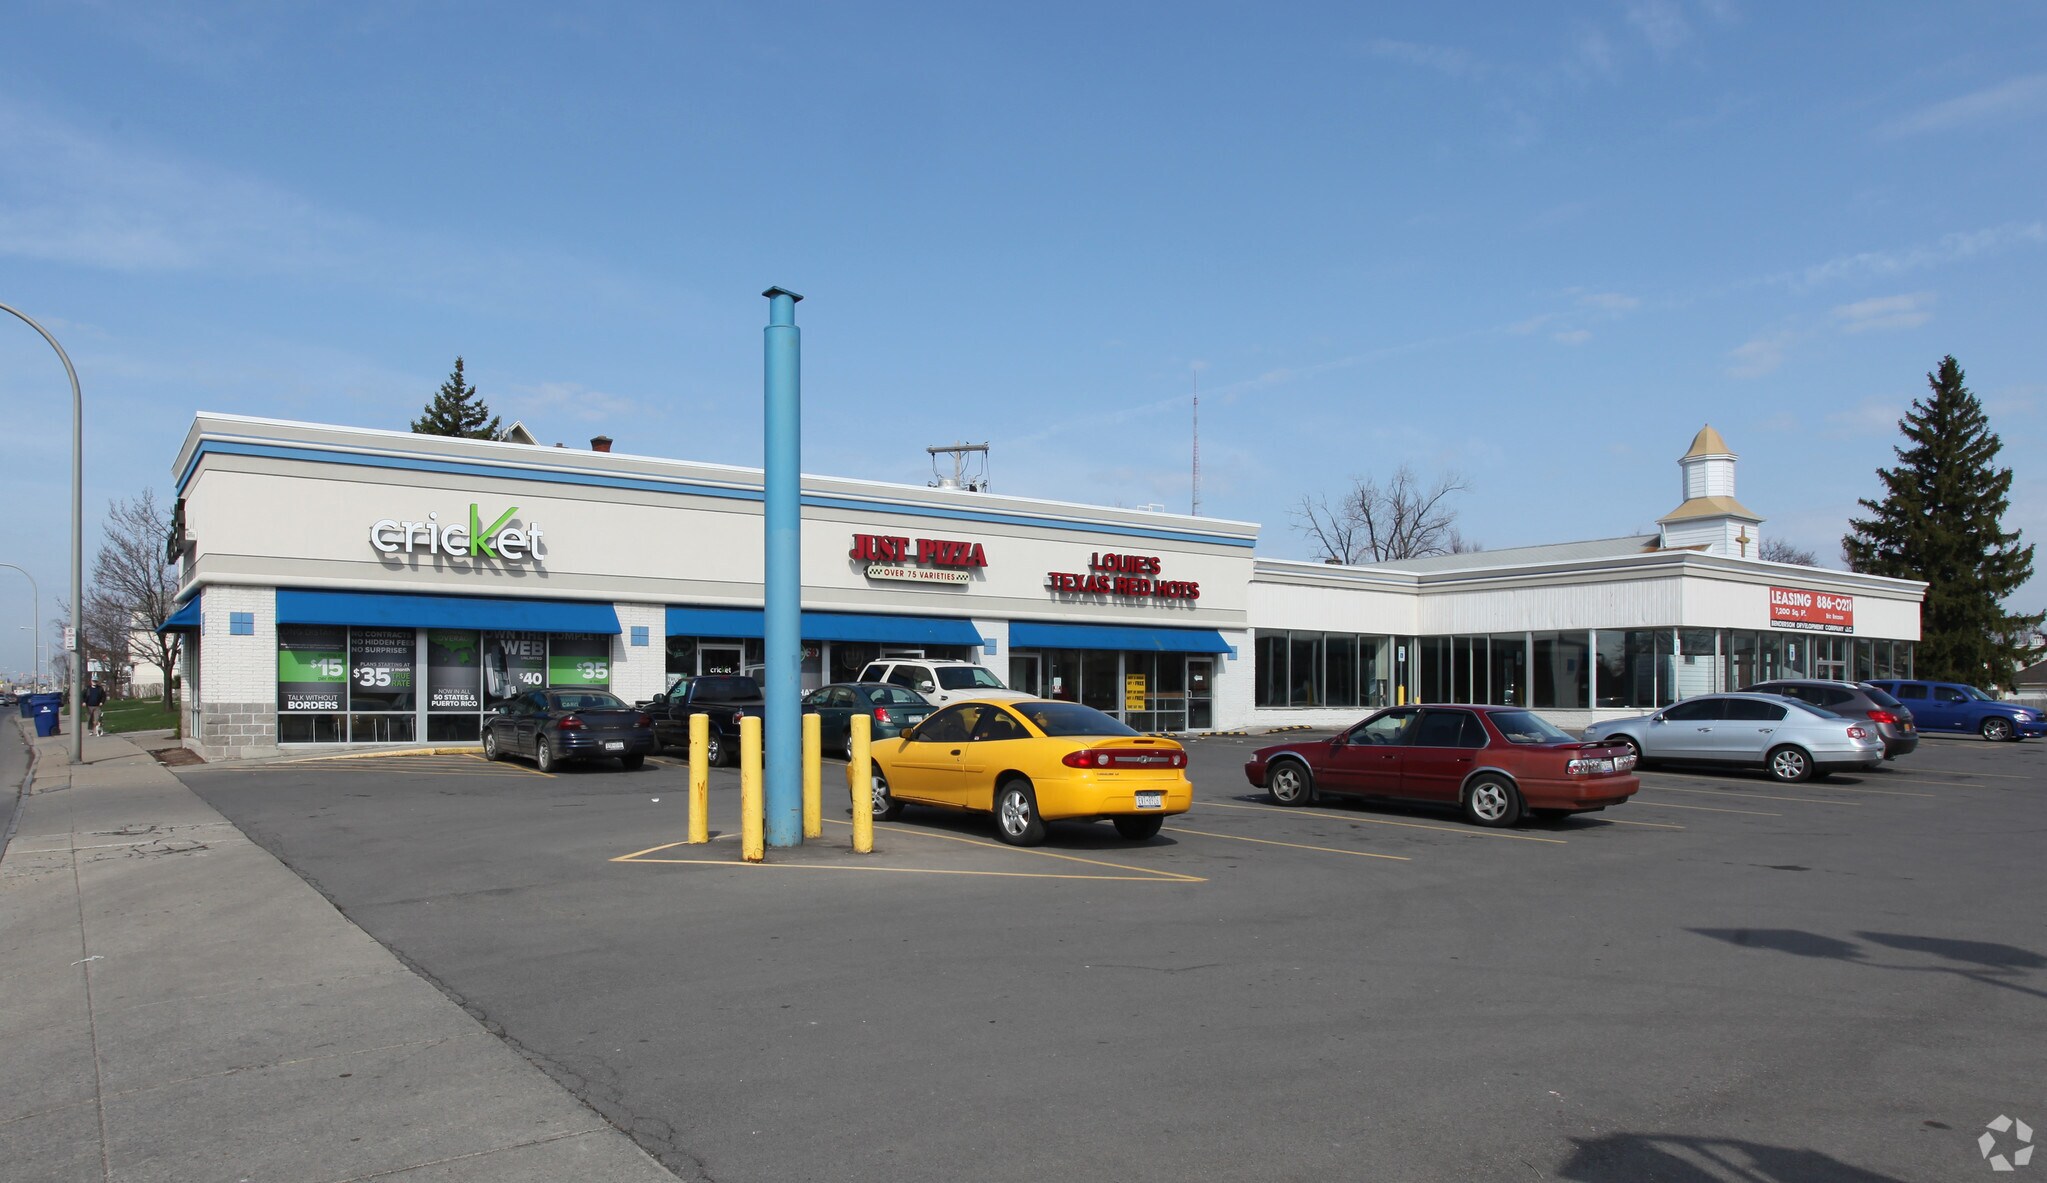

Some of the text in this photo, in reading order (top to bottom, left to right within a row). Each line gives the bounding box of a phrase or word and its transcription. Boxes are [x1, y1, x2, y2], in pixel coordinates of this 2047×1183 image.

[370, 503, 545, 560] cricket
[849, 533, 988, 567] JUST PIZZA
[1090, 552, 1161, 575] LOUIE'S
[884, 568, 955, 580] OVER 75 VARIETIES
[1048, 572, 1200, 599] TEXAS RED HOTS
[1771, 590, 1811, 607] LEASING
[365, 631, 412, 639] CONTRACTS
[501, 640, 544, 655] WEB
[311, 658, 343, 677] $15
[576, 662, 608, 679] $35
[353, 667, 391, 687] $35
[519, 672, 542, 685] $40
[287, 701, 338, 710] BORDERS
